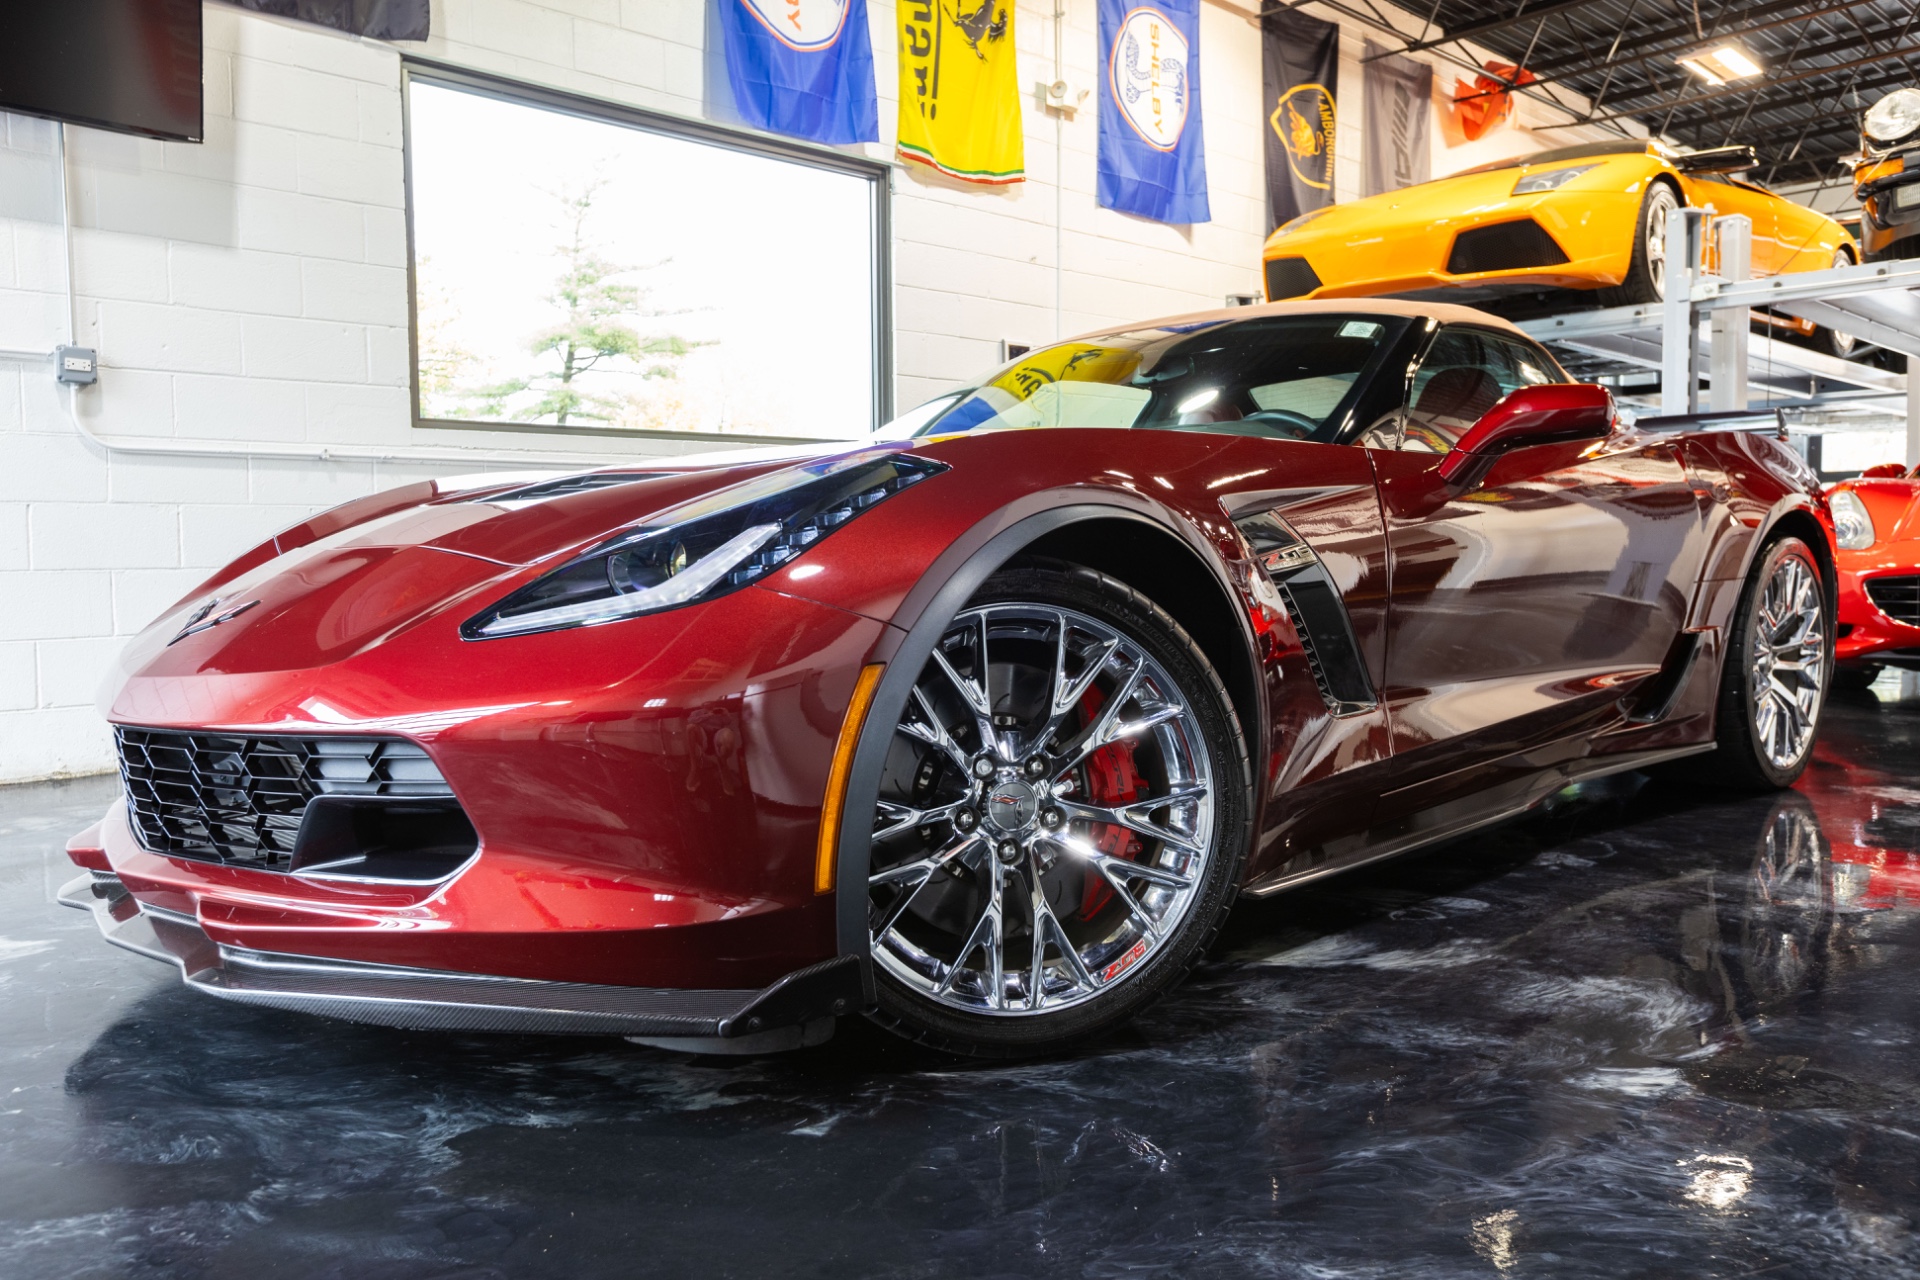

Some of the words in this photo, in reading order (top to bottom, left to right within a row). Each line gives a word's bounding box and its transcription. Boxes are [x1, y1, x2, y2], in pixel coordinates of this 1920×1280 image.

[1150, 22, 1163, 135] SHELBY
[1318, 95, 1336, 181] LAMBORGHINI
[1101, 939, 1146, 982] Z06
